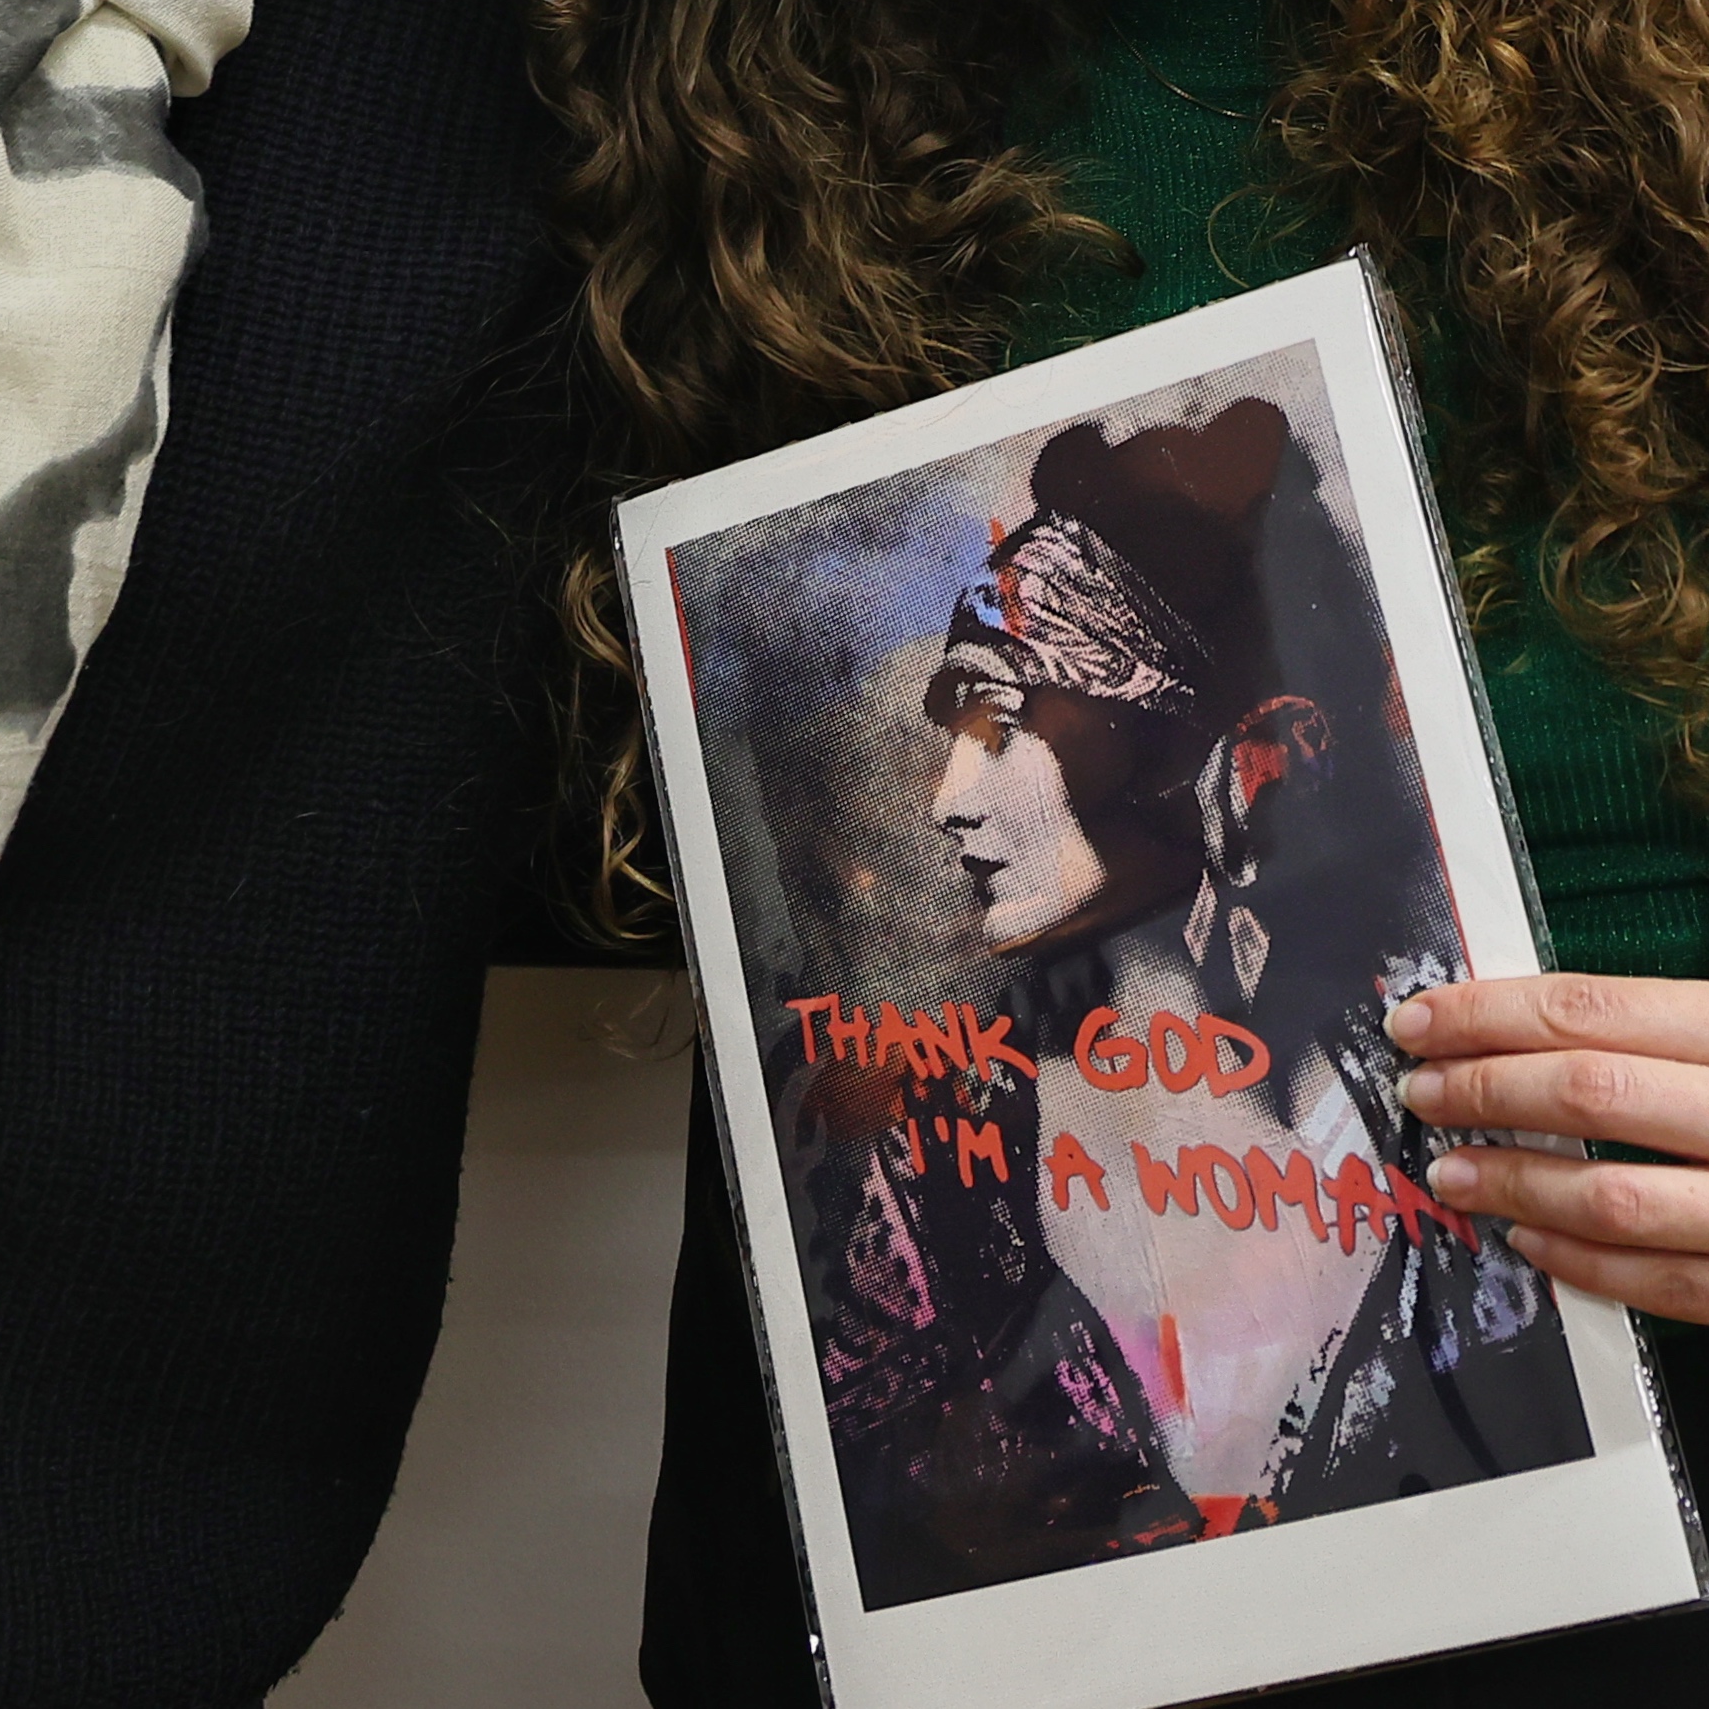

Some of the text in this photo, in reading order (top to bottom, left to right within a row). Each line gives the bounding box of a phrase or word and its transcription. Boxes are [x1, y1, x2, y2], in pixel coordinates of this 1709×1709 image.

[785, 993, 1271, 1099] THANK GOD
[907, 1116, 1481, 1256] I'M A WOMAN
